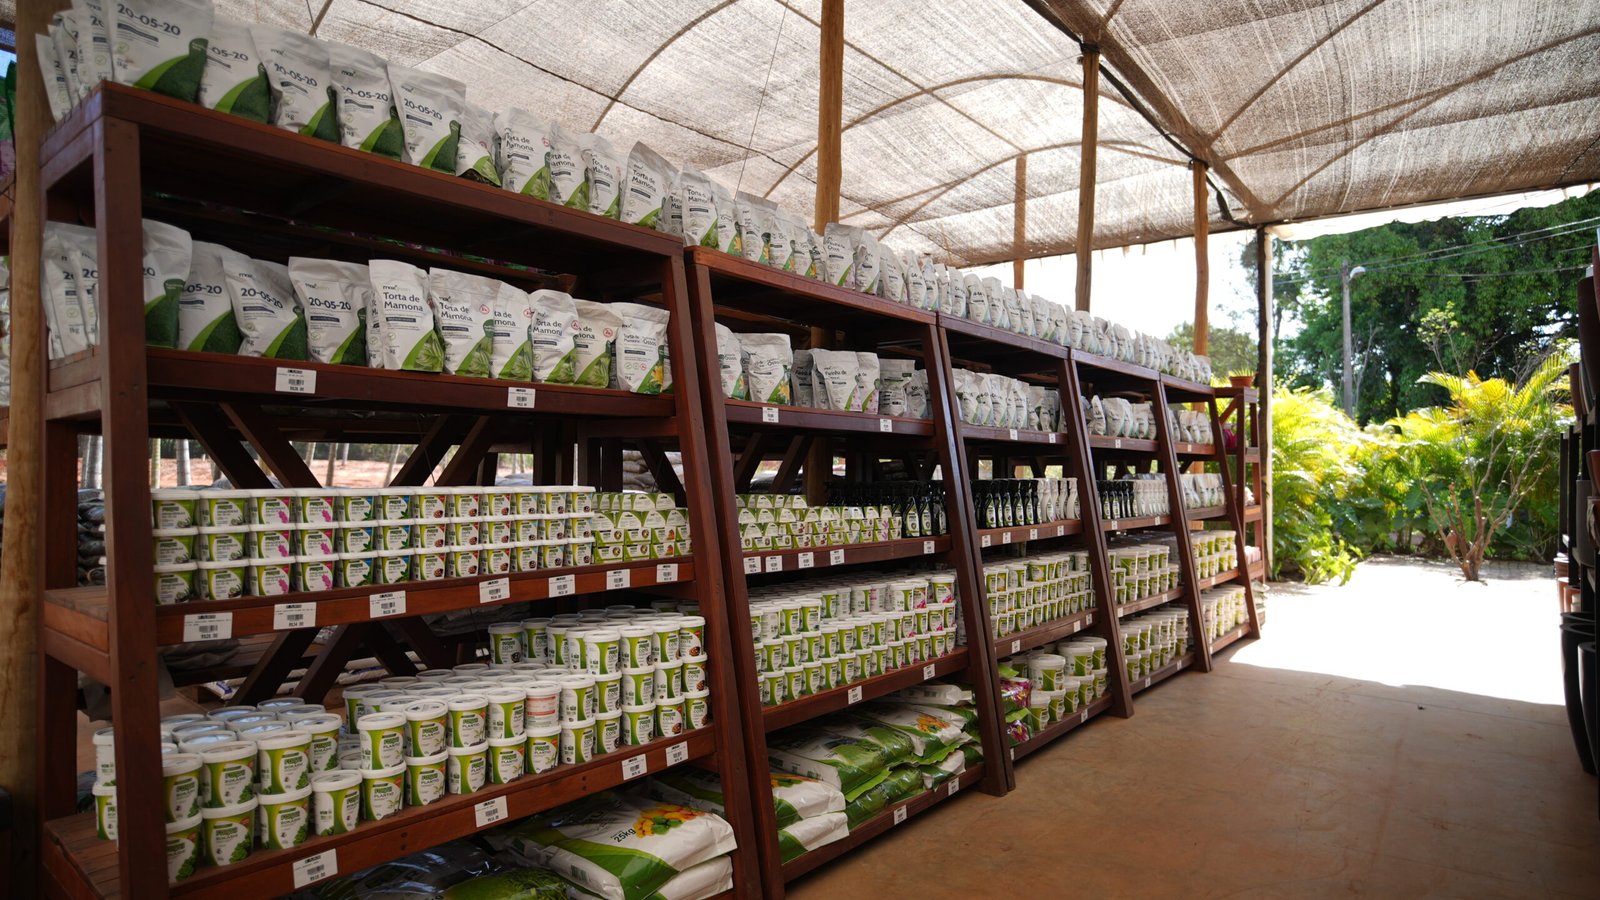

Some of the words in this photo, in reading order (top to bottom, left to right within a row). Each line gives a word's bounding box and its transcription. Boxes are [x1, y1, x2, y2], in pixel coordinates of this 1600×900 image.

[117, 4, 181, 36] 20-05-20
[274, 63, 318, 87] 20-05-20
[404, 98, 443, 120] 20-05-20
[521, 136, 530, 144] de
[633, 170, 648, 181] Torta
[632, 177, 657, 193] Mamona
[241, 287, 283, 309] 20-05-20
[383, 291, 407, 301] Torta
[409, 294, 420, 302] de
[309, 296, 351, 310] 20-05-20
[384, 301, 424, 312] Mamona
[460, 305, 469, 313] de
[503, 310, 512, 318] de
[440, 311, 473, 322] Mamona
[536, 318, 551, 327] Torta
[552, 320, 562, 328] de
[613, 828, 636, 843] 25kg
